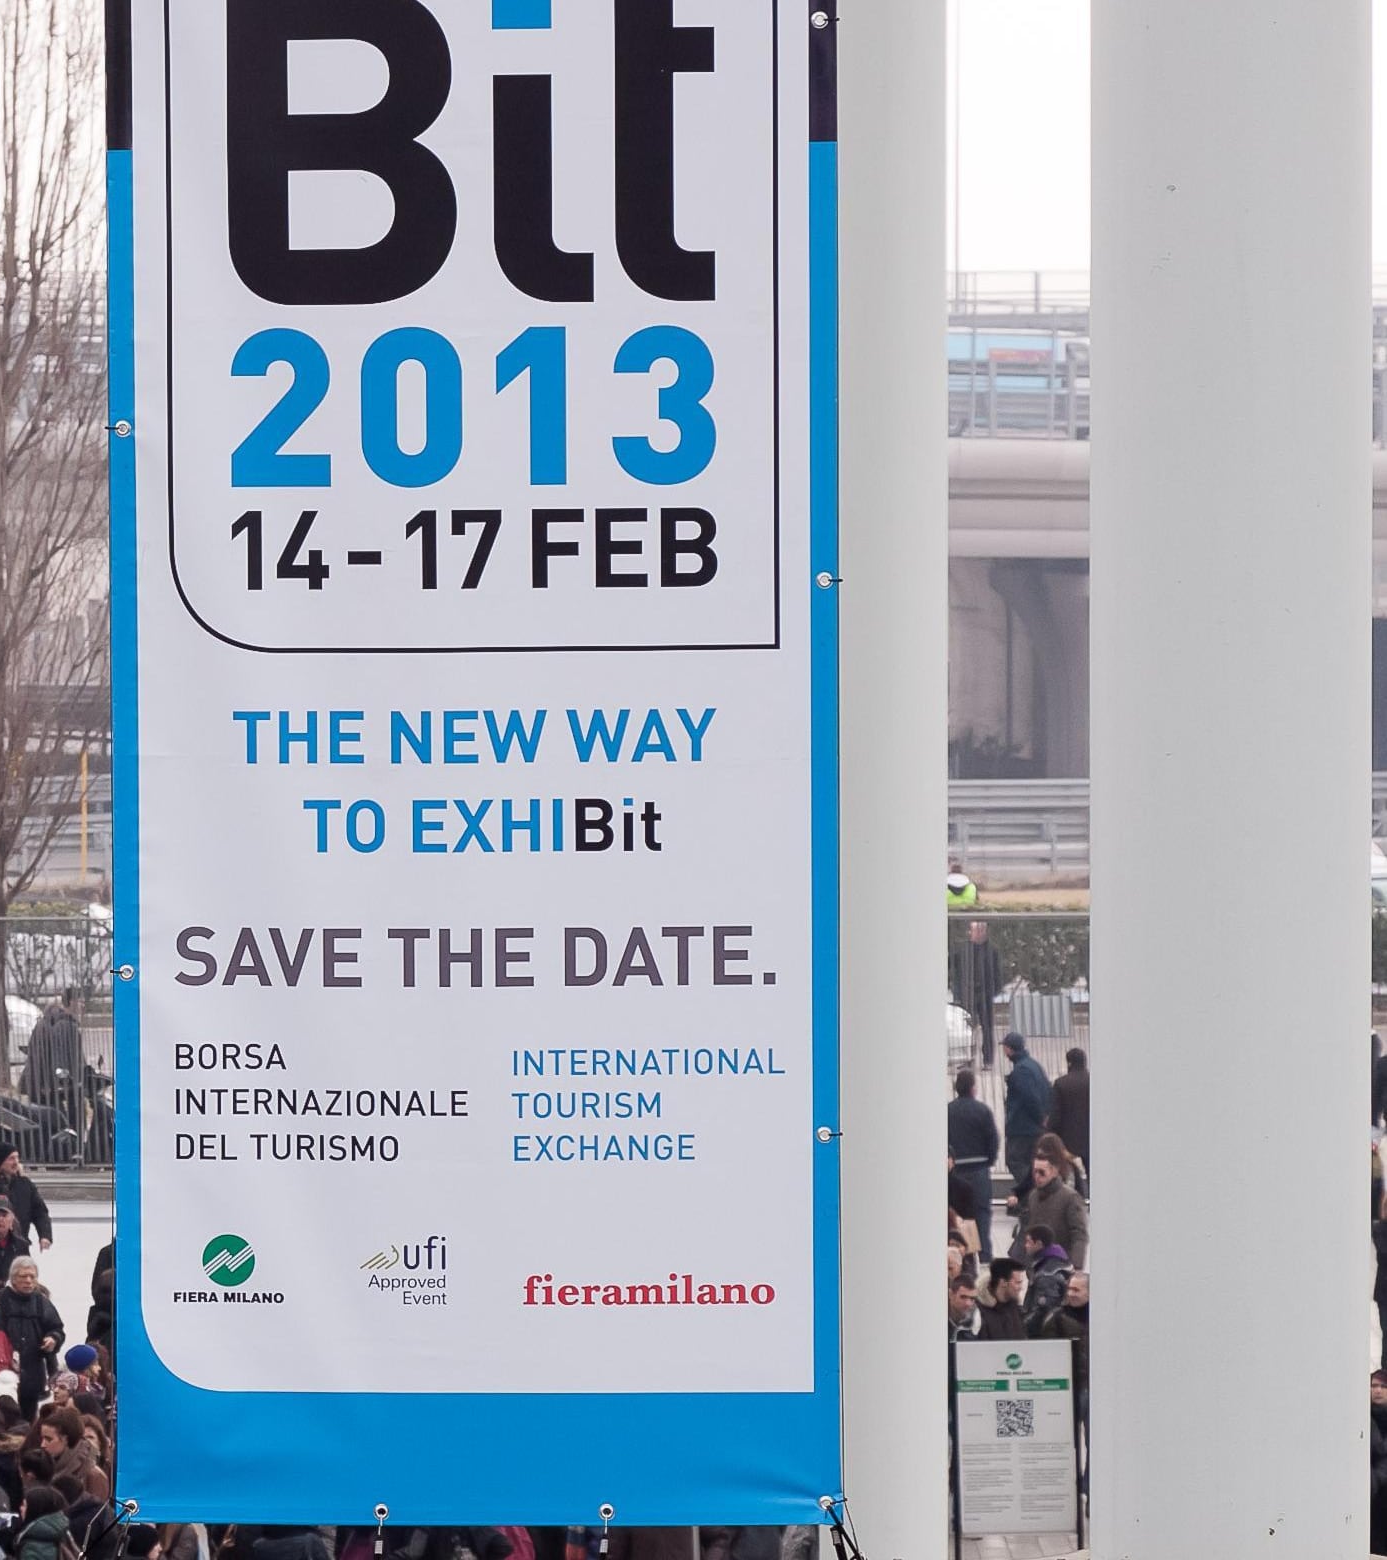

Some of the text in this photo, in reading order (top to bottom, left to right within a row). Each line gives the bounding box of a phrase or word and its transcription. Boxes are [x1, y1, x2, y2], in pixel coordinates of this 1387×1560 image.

[226, 0, 716, 306] Bit
[230, 324, 717, 489] 2013
[531, 507, 718, 589] FEB
[232, 707, 717, 765] THE NEW WAY
[302, 797, 662, 853] TO EXHIBit
[174, 925, 777, 988] SAVE THE DATE.
[175, 1043, 287, 1070] BORSA
[513, 1048, 786, 1076] INTERNATIONAL
[175, 1089, 469, 1117] INTERNAZIONALE
[511, 1091, 662, 1118] TOURISM
[175, 1133, 399, 1162] DEL TURISMO
[513, 1134, 696, 1161] EXCHANGE
[403, 1235, 447, 1270] ufi
[368, 1274, 447, 1291] Approved
[522, 1273, 776, 1306] fieramilano
[173, 1291, 285, 1304] FIERA MILANO
[402, 1290, 447, 1305] Event
